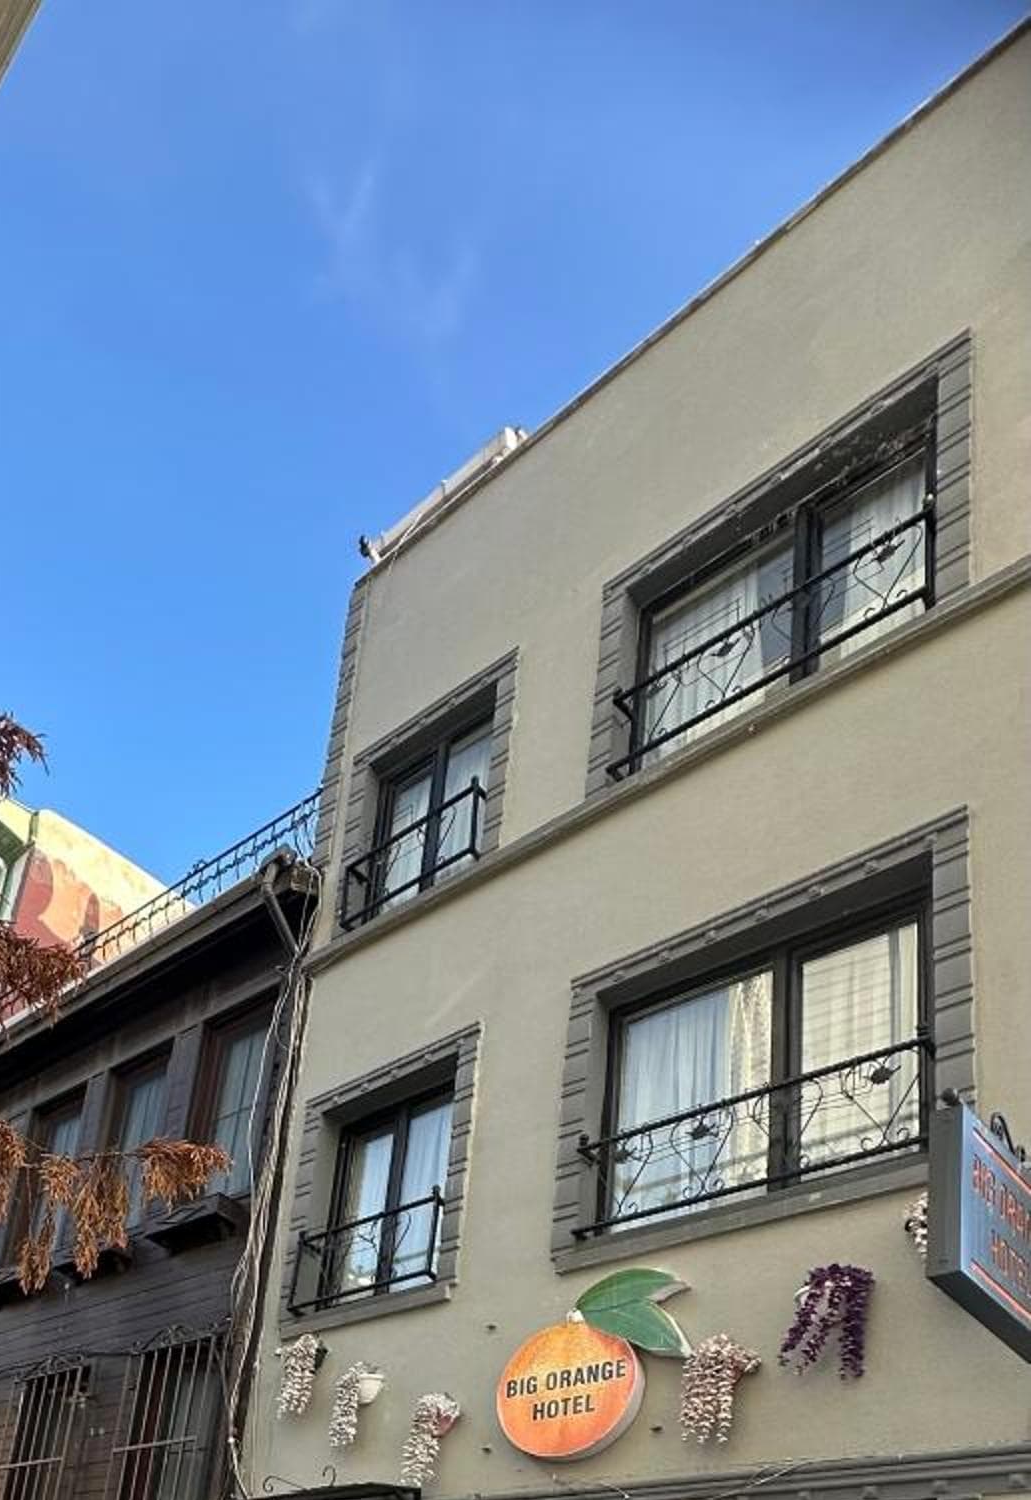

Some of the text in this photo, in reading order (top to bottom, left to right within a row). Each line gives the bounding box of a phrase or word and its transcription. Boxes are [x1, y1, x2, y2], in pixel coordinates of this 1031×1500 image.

[506, 1358, 626, 1398] BIG ORANGE
[532, 1394, 596, 1421] HOTEL
